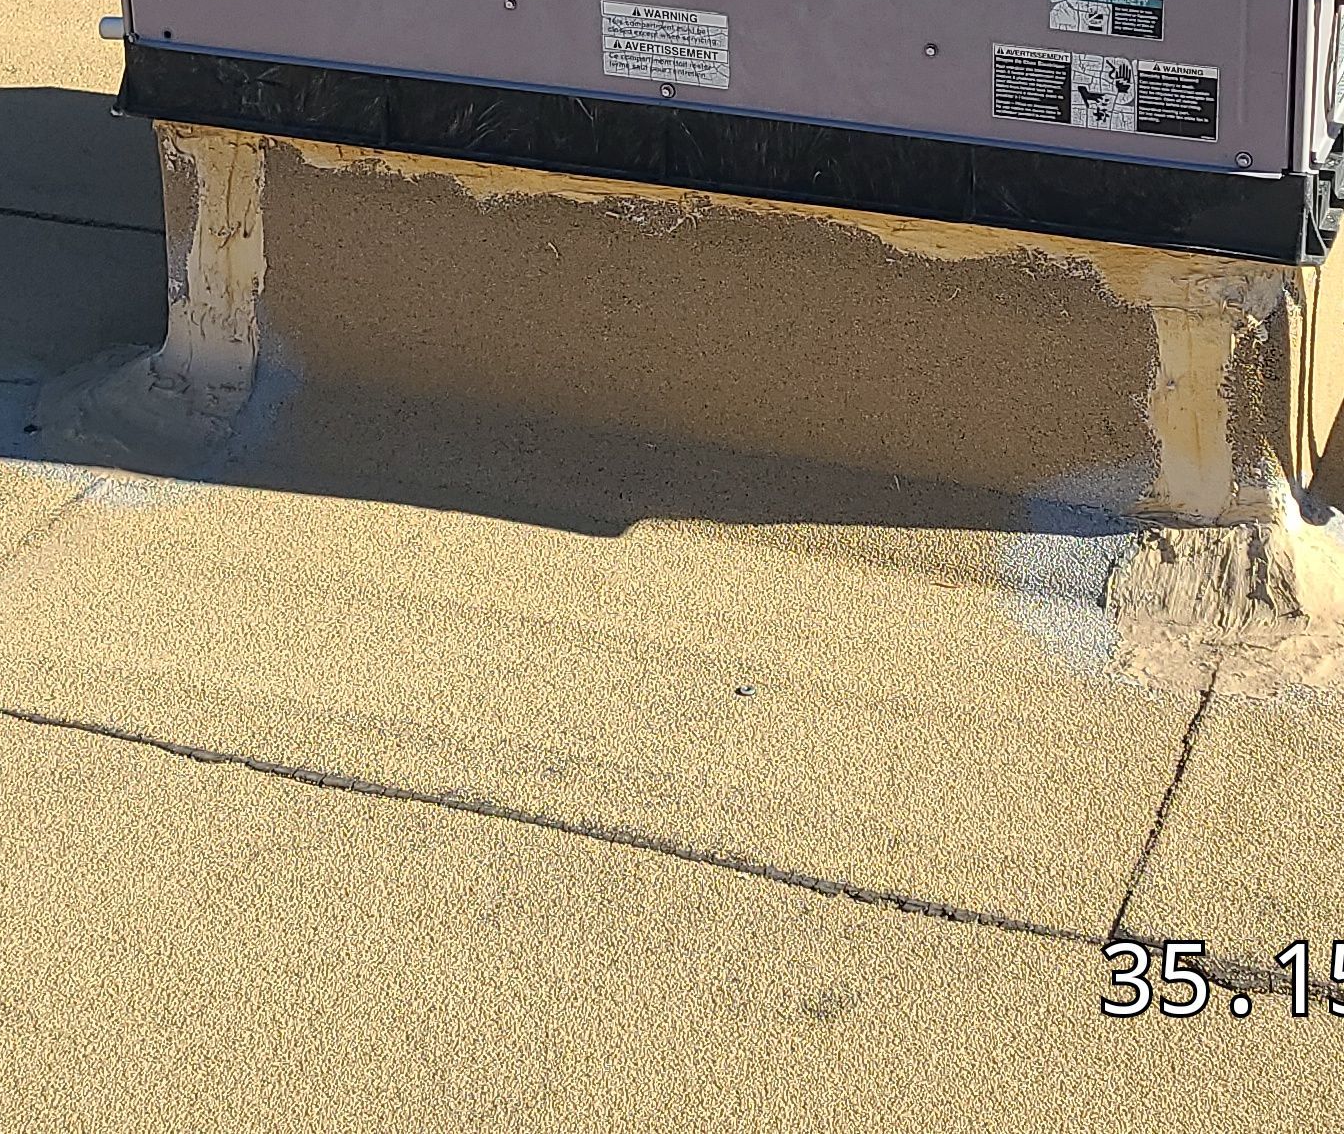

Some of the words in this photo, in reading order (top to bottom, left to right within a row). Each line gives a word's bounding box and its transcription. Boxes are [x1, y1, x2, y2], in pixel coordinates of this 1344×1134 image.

[644, 8, 698, 23] WARNING
[625, 41, 718, 60] AVERTISSEMENT
[1006, 49, 1070, 61] AVERTISSEMENT
[1163, 65, 1204, 76] WARNING
